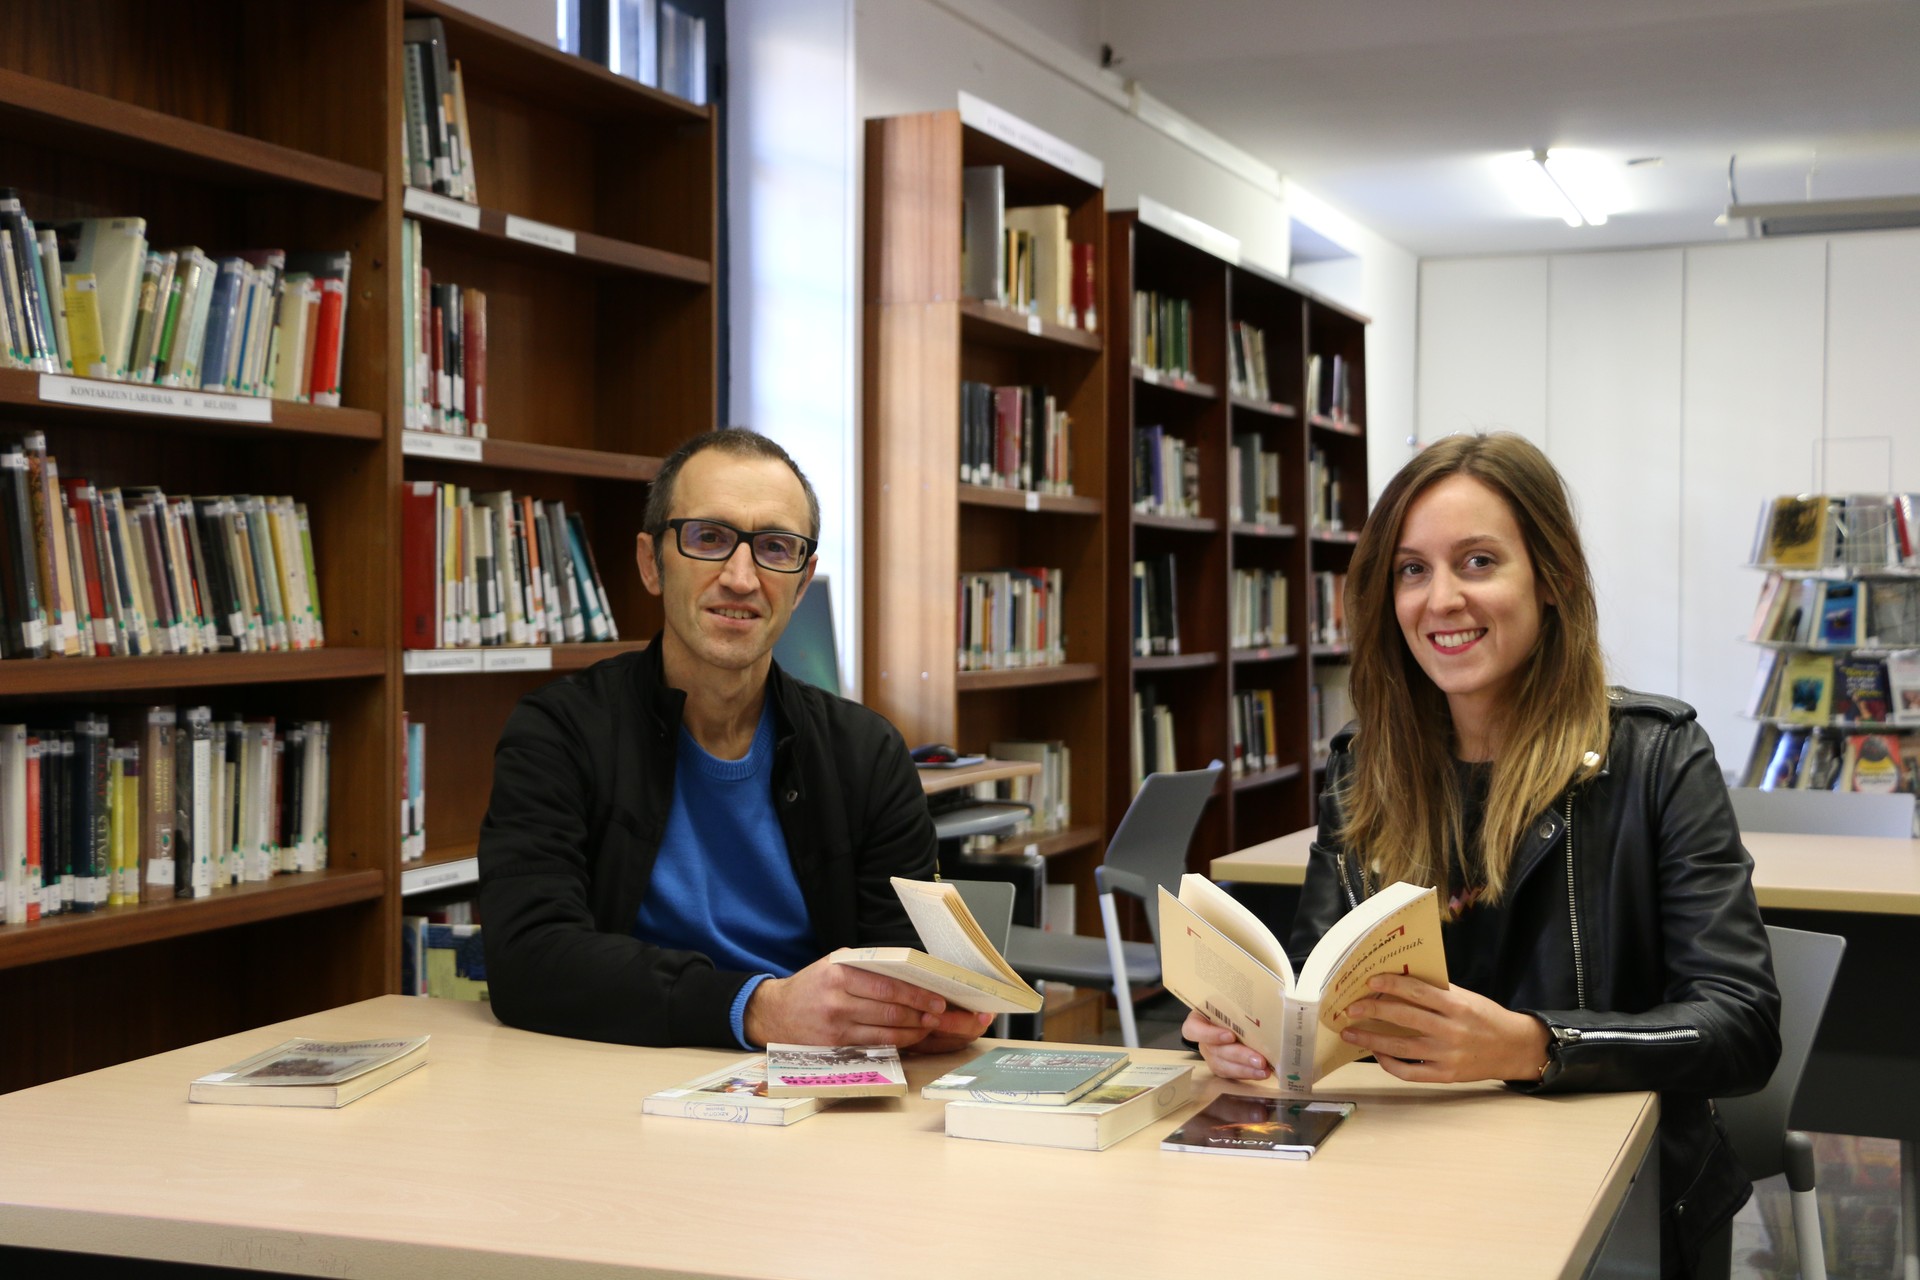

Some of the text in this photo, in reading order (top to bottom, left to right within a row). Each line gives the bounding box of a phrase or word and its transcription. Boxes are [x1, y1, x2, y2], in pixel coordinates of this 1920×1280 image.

[70, 384, 128, 401] KONTAKIZUN
[129, 390, 174, 406] LABURRAK
[1379, 936, 1424, 965] ipuinak
[782, 1077, 879, 1085] ZALDIAK
[1208, 1137, 1274, 1146] HORLA
